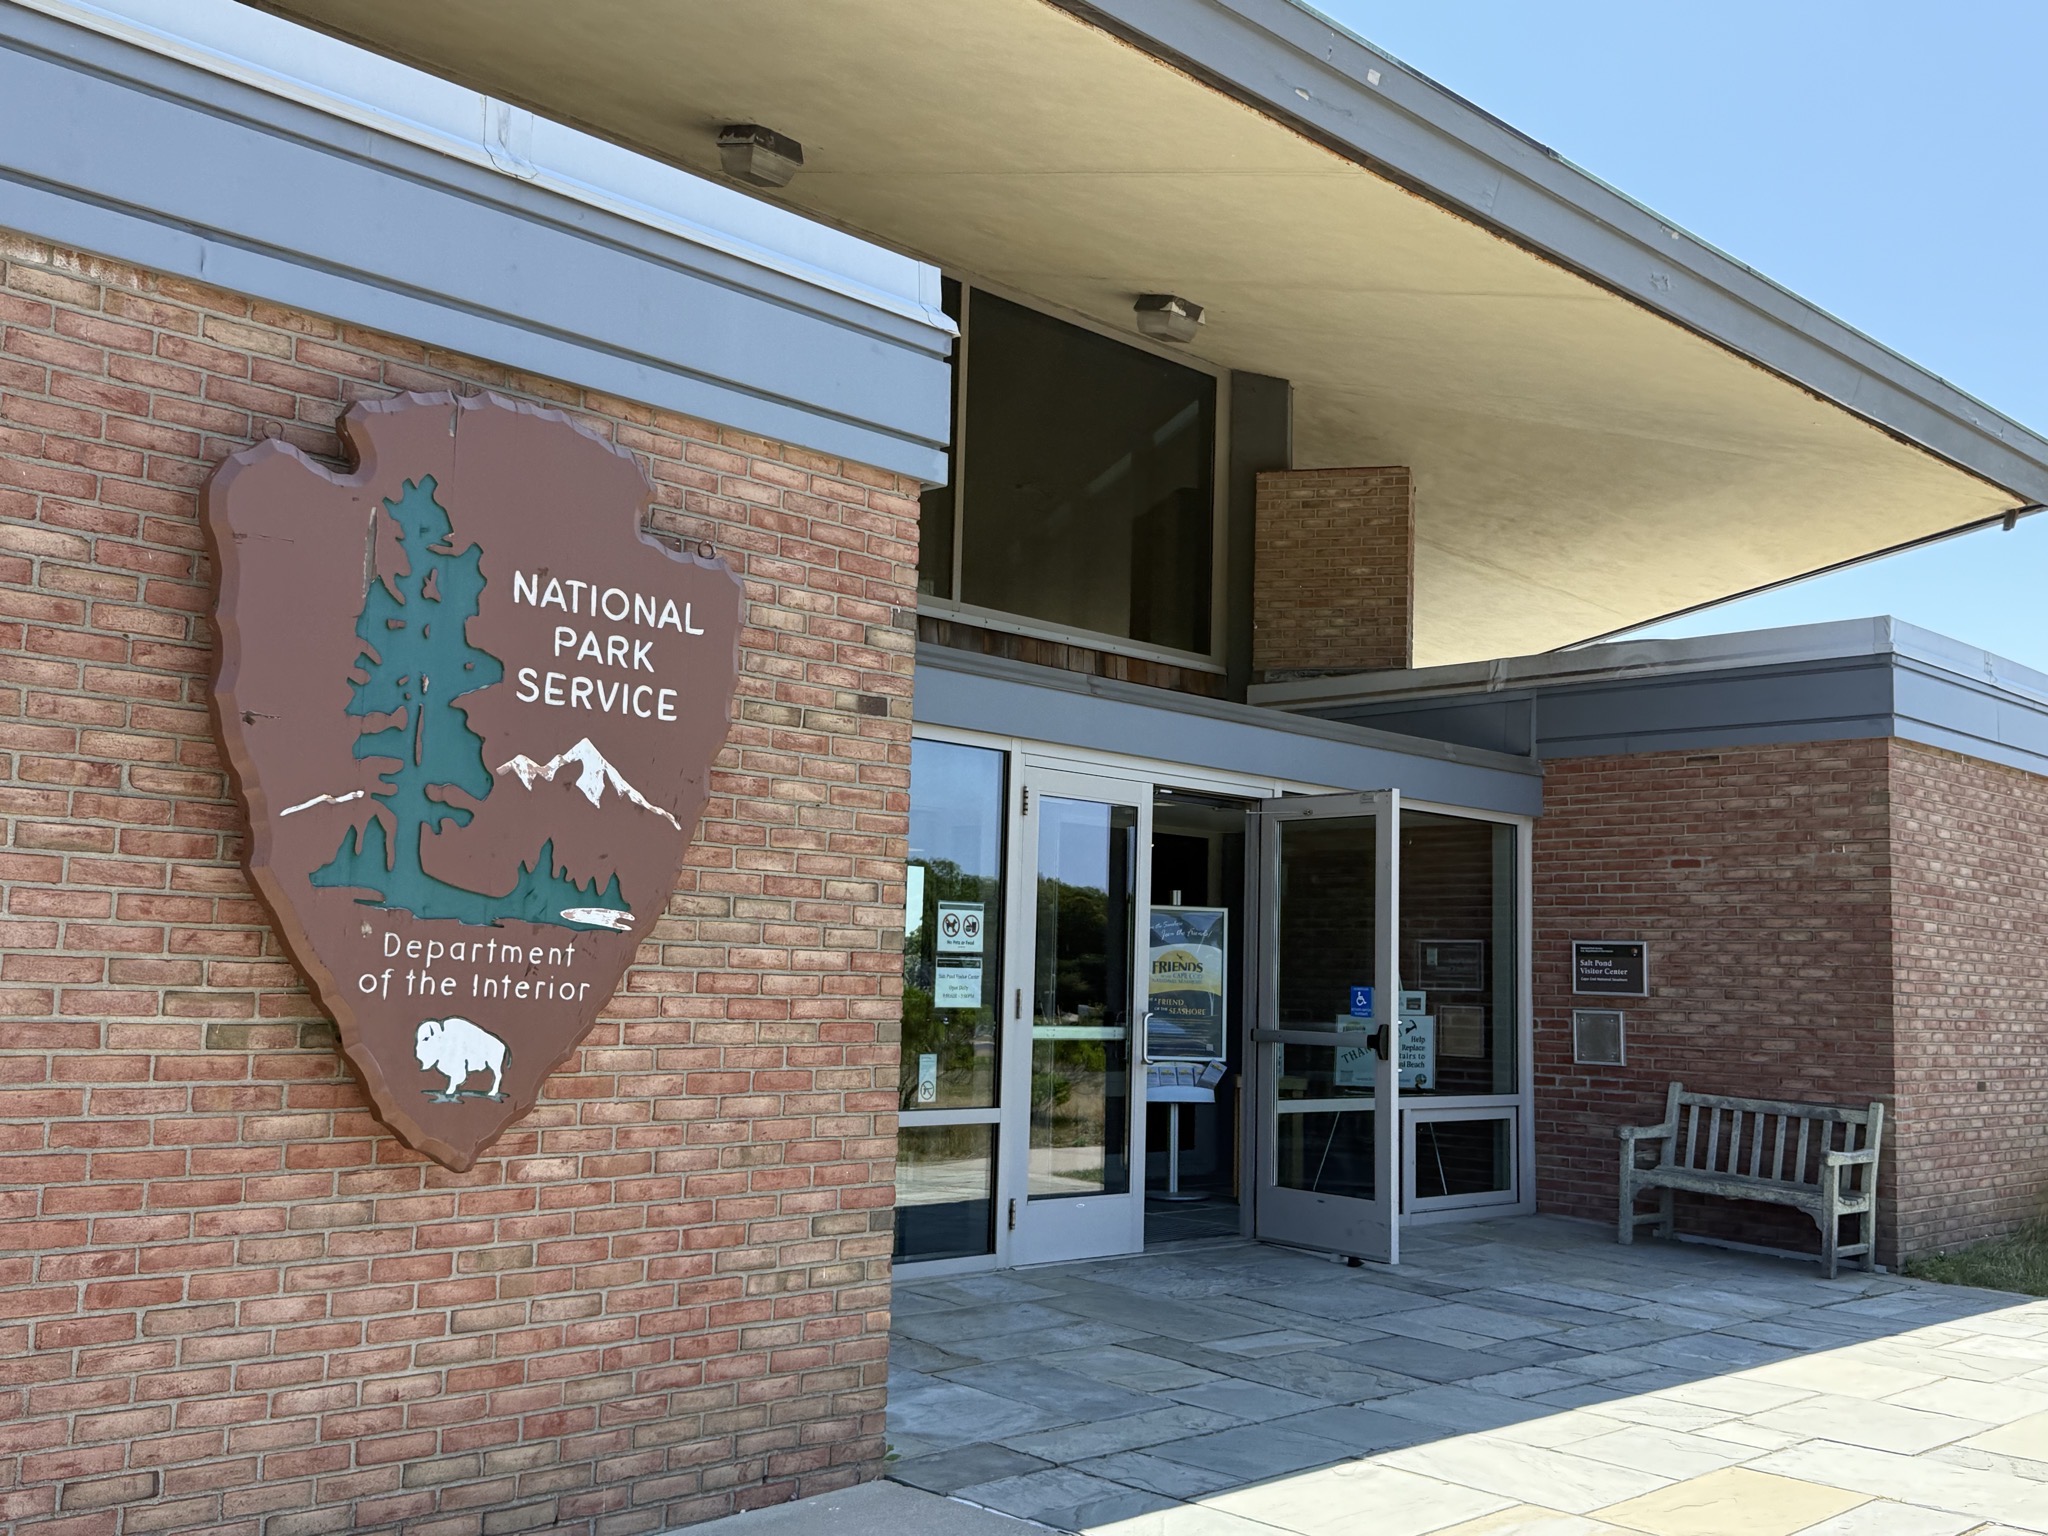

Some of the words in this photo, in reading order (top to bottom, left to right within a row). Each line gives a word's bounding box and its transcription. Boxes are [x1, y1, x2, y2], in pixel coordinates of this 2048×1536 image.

[513, 570, 704, 635] NATIONAL
[554, 626, 655, 672] PARK
[516, 667, 678, 721] SERVICE
[384, 931, 575, 968] Department
[1152, 960, 1203, 974] FRIENDS
[1580, 967, 1603, 975] Visitor
[1604, 967, 1628, 975] Center
[359, 969, 394, 1000] of
[406, 969, 457, 996] the
[473, 974, 590, 1001] Interior
[1157, 998, 1184, 1006] FRIEND
[1402, 1044, 1425, 1052] Replace
[1411, 1036, 1425, 1045] Help
